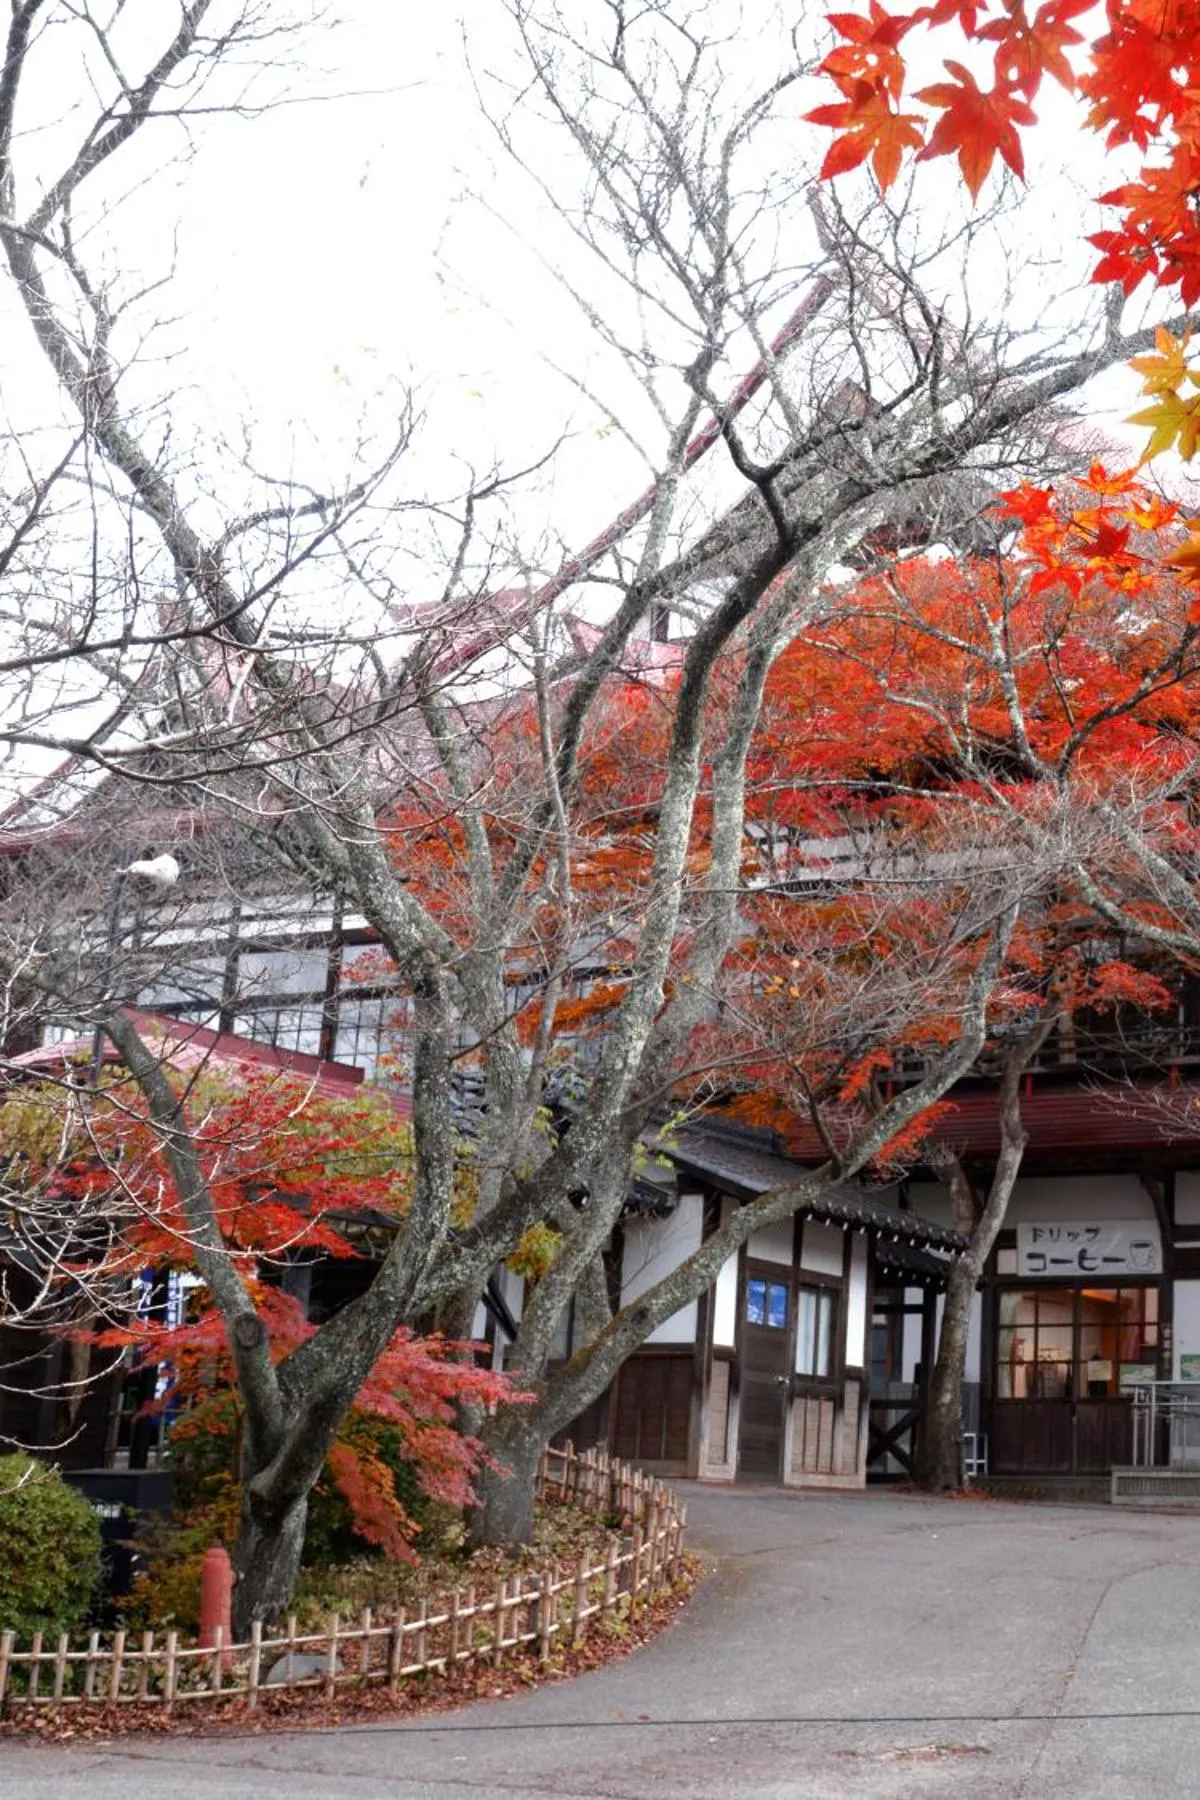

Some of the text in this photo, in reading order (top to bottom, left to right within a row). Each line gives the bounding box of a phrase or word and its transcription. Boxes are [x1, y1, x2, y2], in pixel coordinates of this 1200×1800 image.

[1031, 1227, 1101, 1243] ドリップ
[1026, 1248, 1126, 1272] コーヒー
